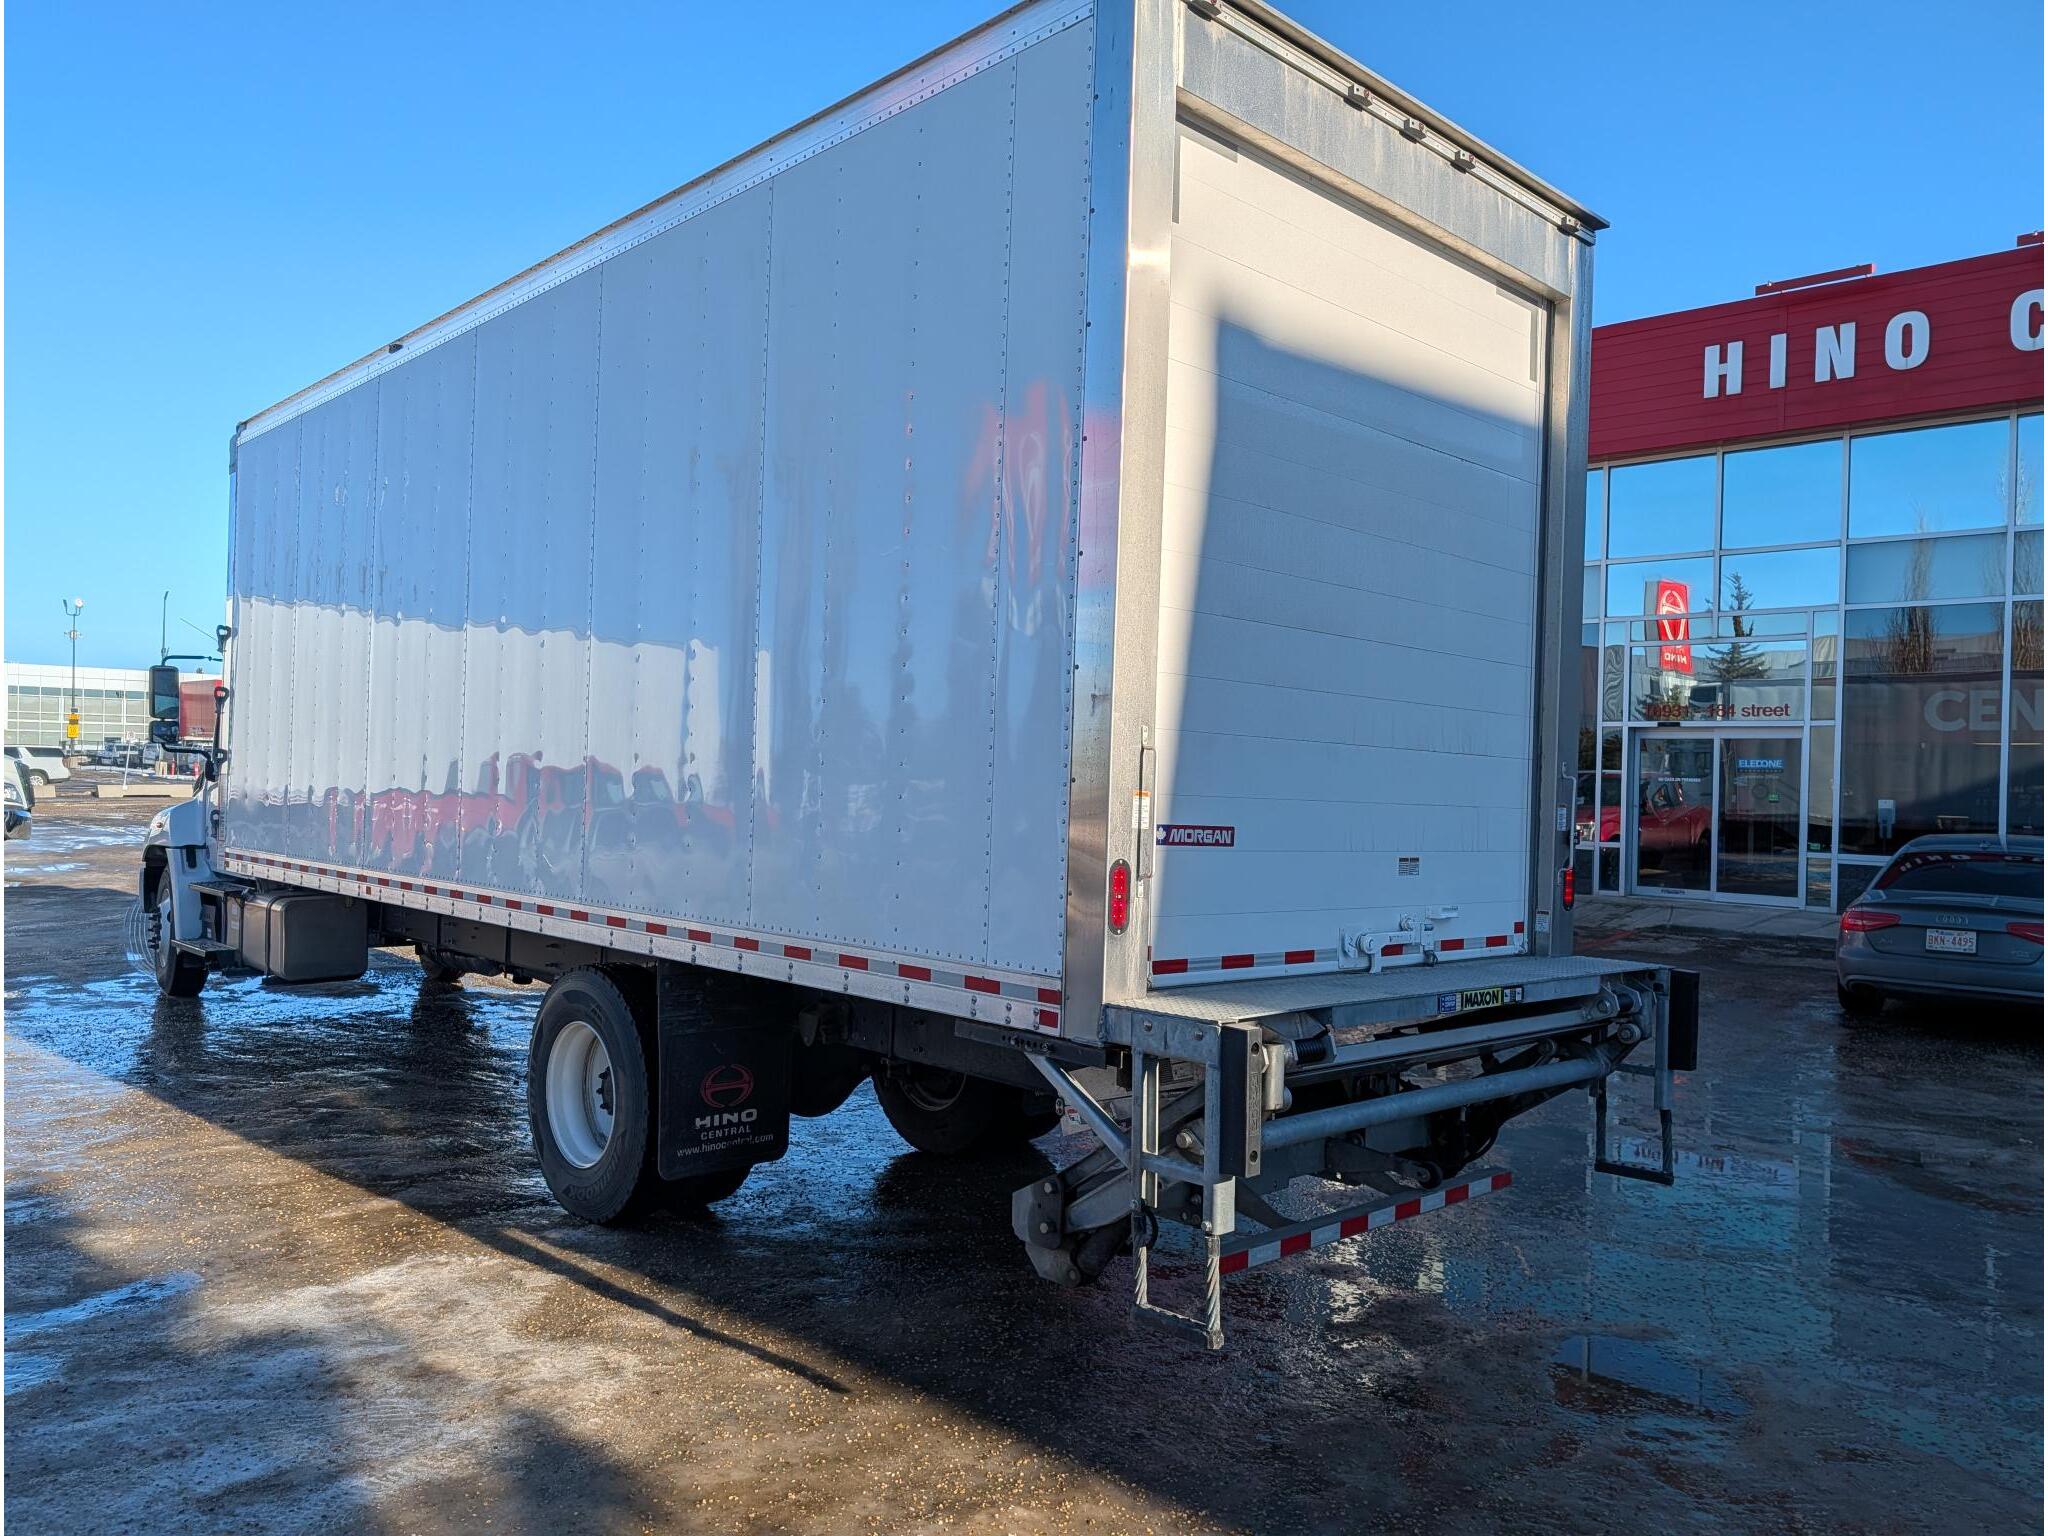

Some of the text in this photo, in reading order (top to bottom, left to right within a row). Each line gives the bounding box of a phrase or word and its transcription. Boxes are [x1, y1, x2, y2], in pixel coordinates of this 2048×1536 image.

[1703, 310, 1930, 399] HINO
[1741, 703, 1790, 717] street
[1924, 690, 2045, 731] CEN
[1168, 828, 1232, 844] MORGAN
[1464, 989, 1500, 1009] MAXON
[695, 1108, 758, 1129] HINO
[700, 1125, 751, 1140] CENTRAL
